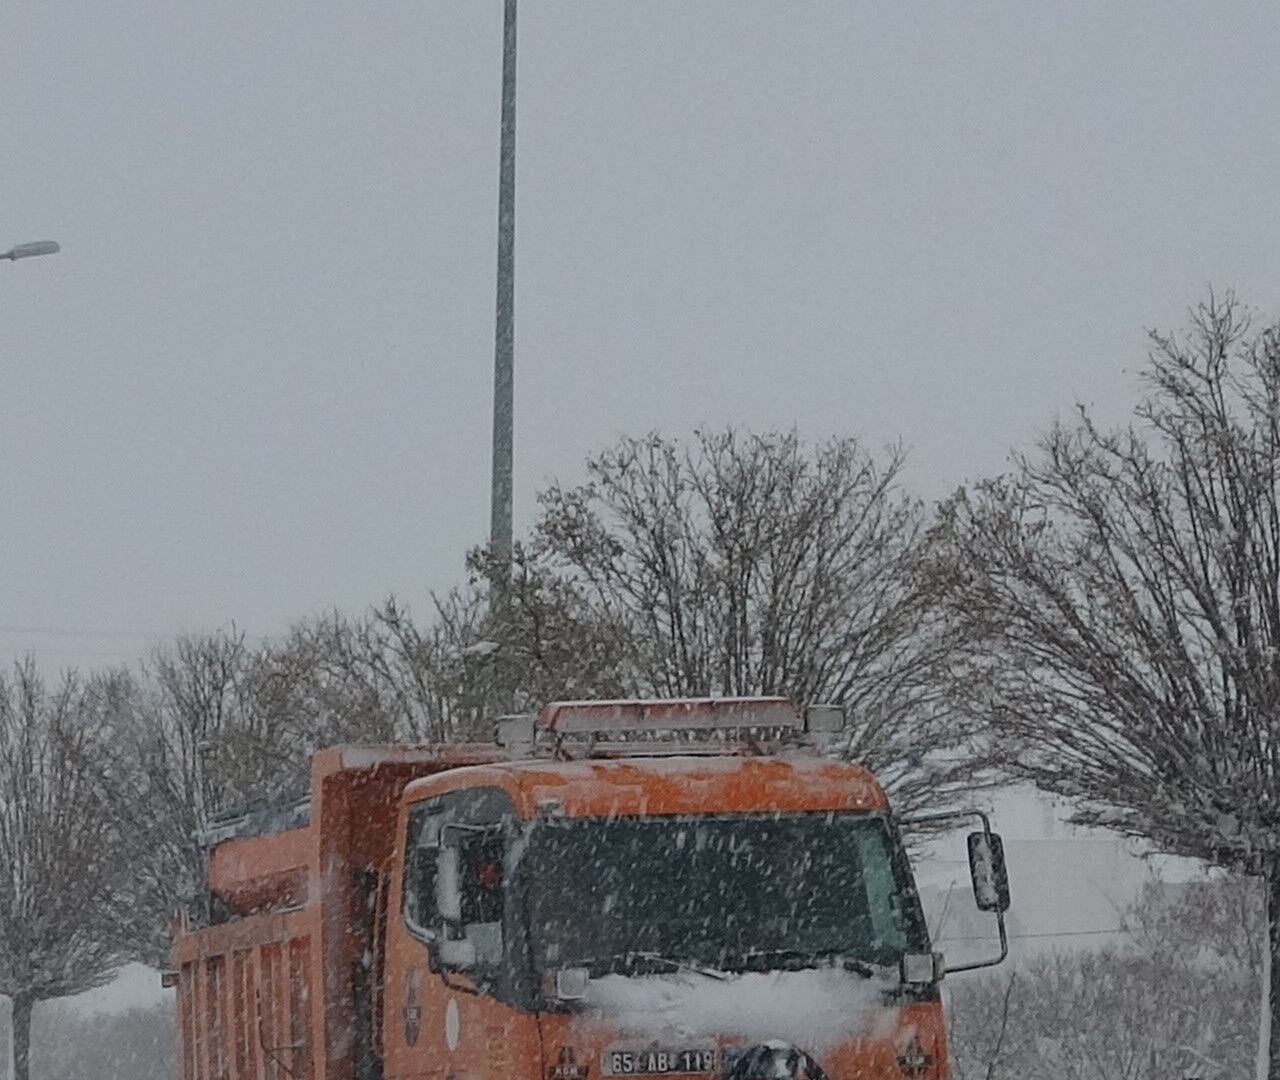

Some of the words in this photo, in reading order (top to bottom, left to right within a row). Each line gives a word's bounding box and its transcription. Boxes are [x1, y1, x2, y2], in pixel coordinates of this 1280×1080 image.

[612, 1053, 633, 1073] 65
[648, 1052, 668, 1072] AB
[684, 1051, 713, 1071] 119
